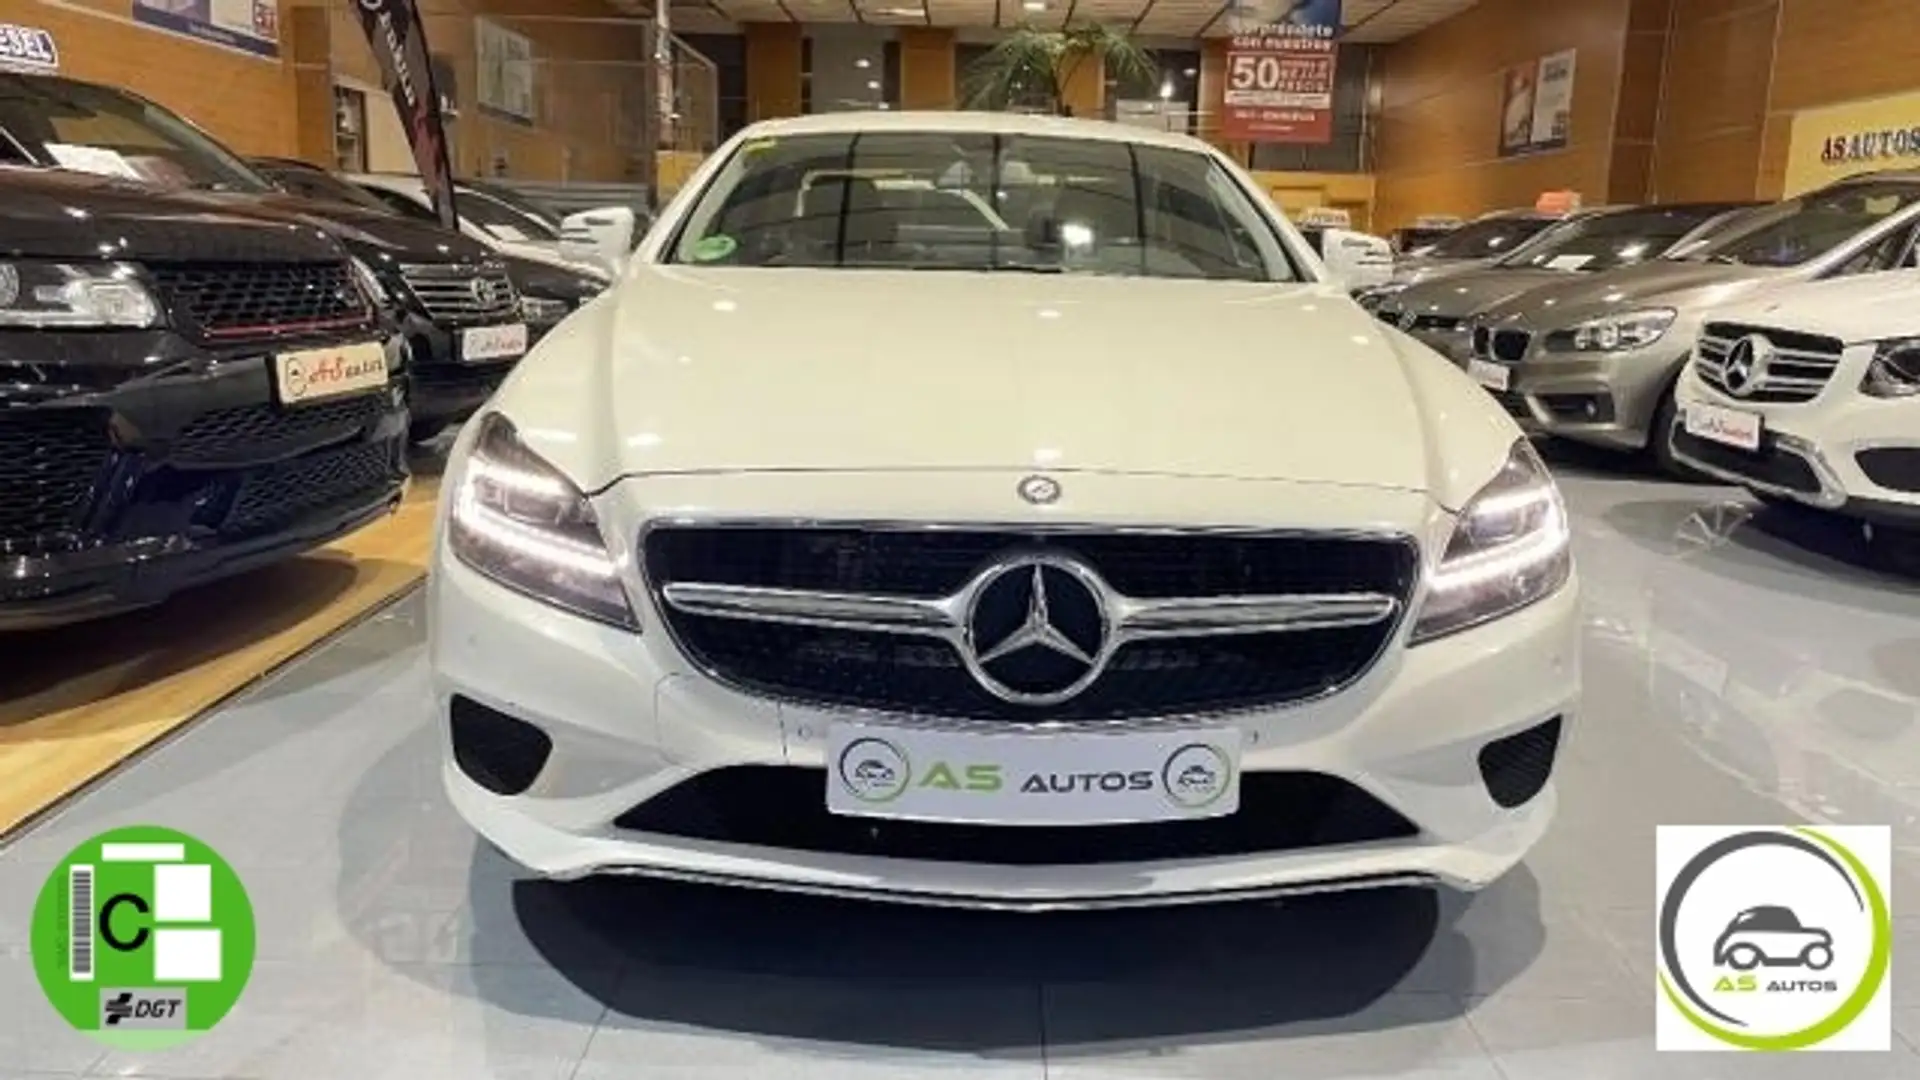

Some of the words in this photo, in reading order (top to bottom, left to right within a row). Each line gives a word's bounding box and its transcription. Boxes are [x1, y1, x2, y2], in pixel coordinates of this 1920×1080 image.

[1230, 57, 1280, 89] 50
[919, 762, 1002, 790] AS
[1020, 771, 1154, 793] AUTOS
